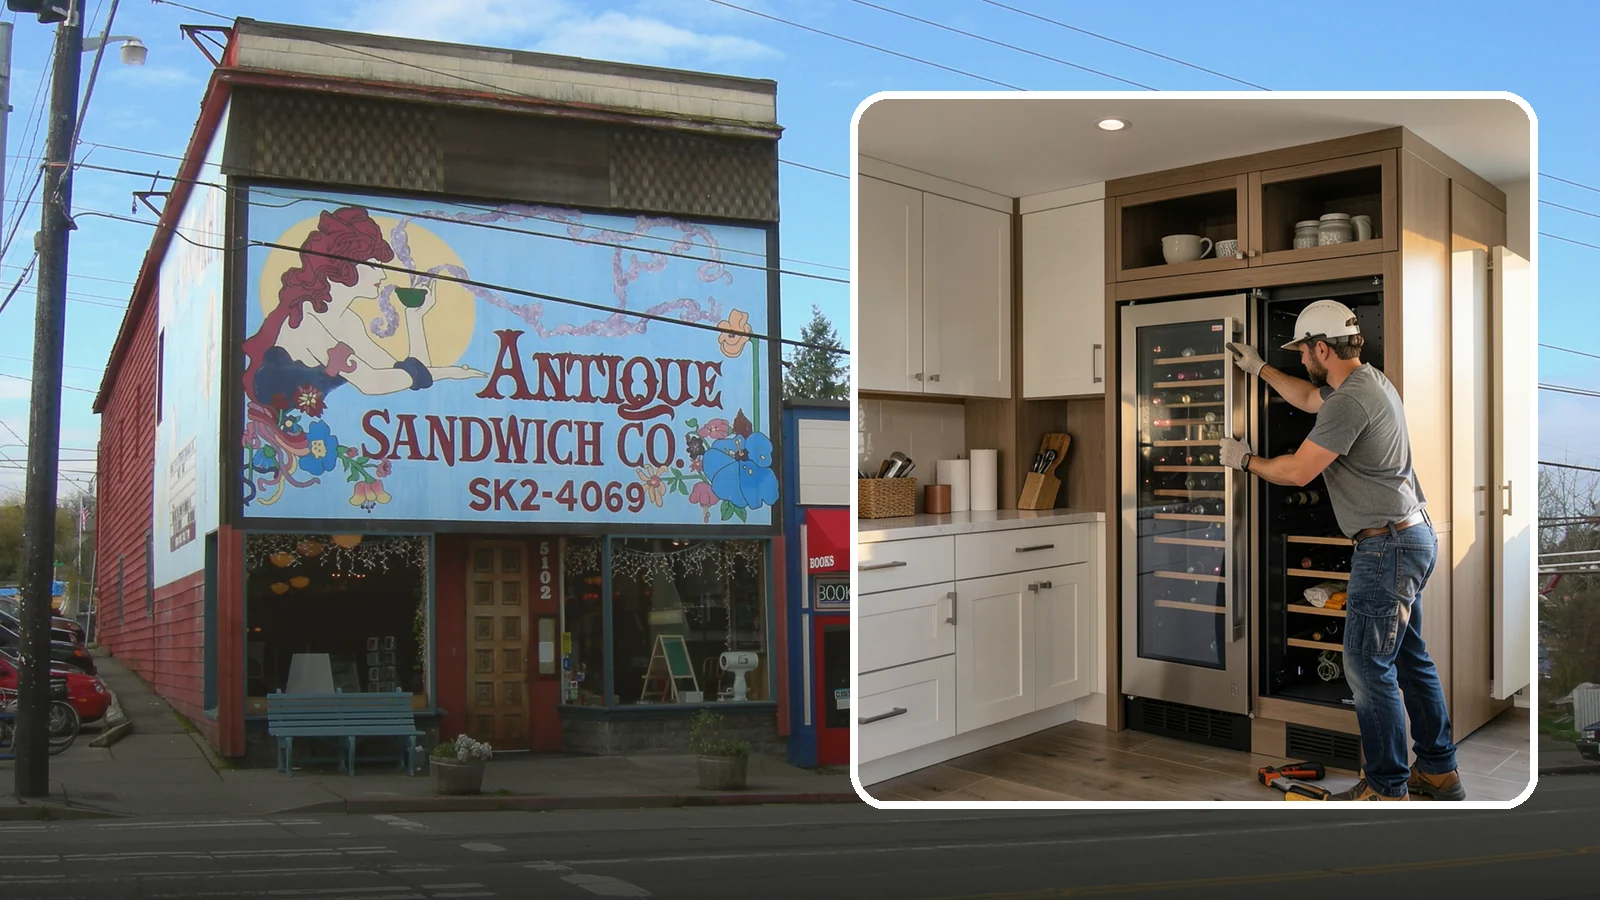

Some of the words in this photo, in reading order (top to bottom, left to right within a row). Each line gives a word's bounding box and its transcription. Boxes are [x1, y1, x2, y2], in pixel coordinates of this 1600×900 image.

[475, 328, 724, 421] ANTIQUE
[361, 408, 605, 467] SANDWICH
[616, 422, 685, 469] CO.
[468, 477, 646, 513] SK2-4069
[809, 555, 835, 569] BOOKS
